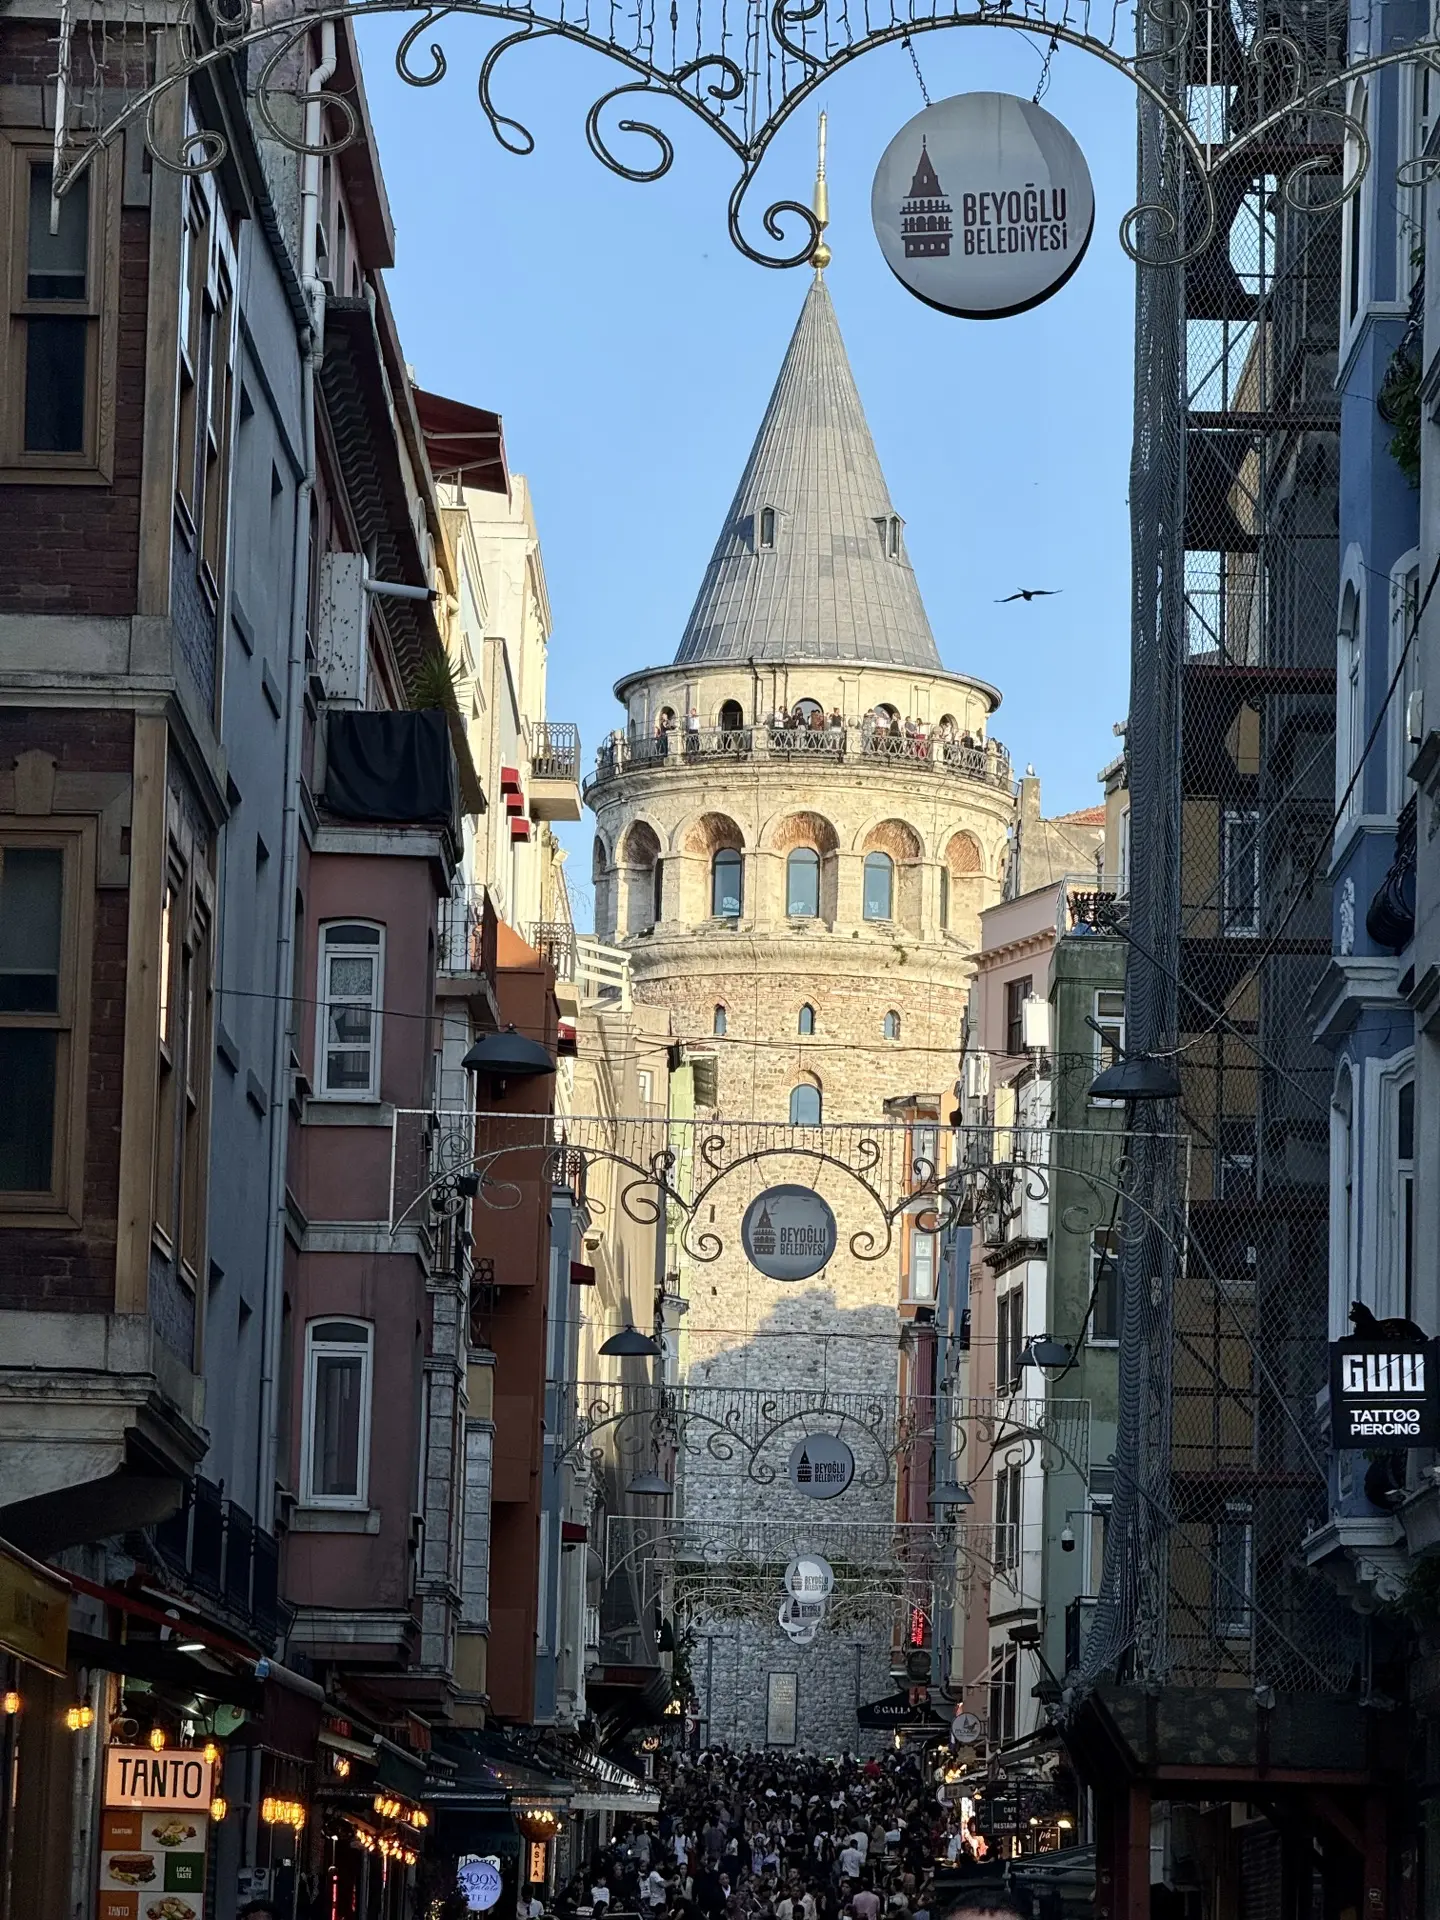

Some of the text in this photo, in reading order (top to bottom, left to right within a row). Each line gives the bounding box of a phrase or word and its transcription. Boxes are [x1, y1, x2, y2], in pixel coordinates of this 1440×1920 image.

[963, 183, 1066, 227] BEYOĞLU
[780, 1225, 826, 1243] BEYOĞLU
[1350, 1409, 1420, 1422] TATTOO
[1351, 1423, 1420, 1435] PIERCING
[814, 1461, 845, 1474] BEYOĞLU
[118, 1758, 203, 1799] TANTO
